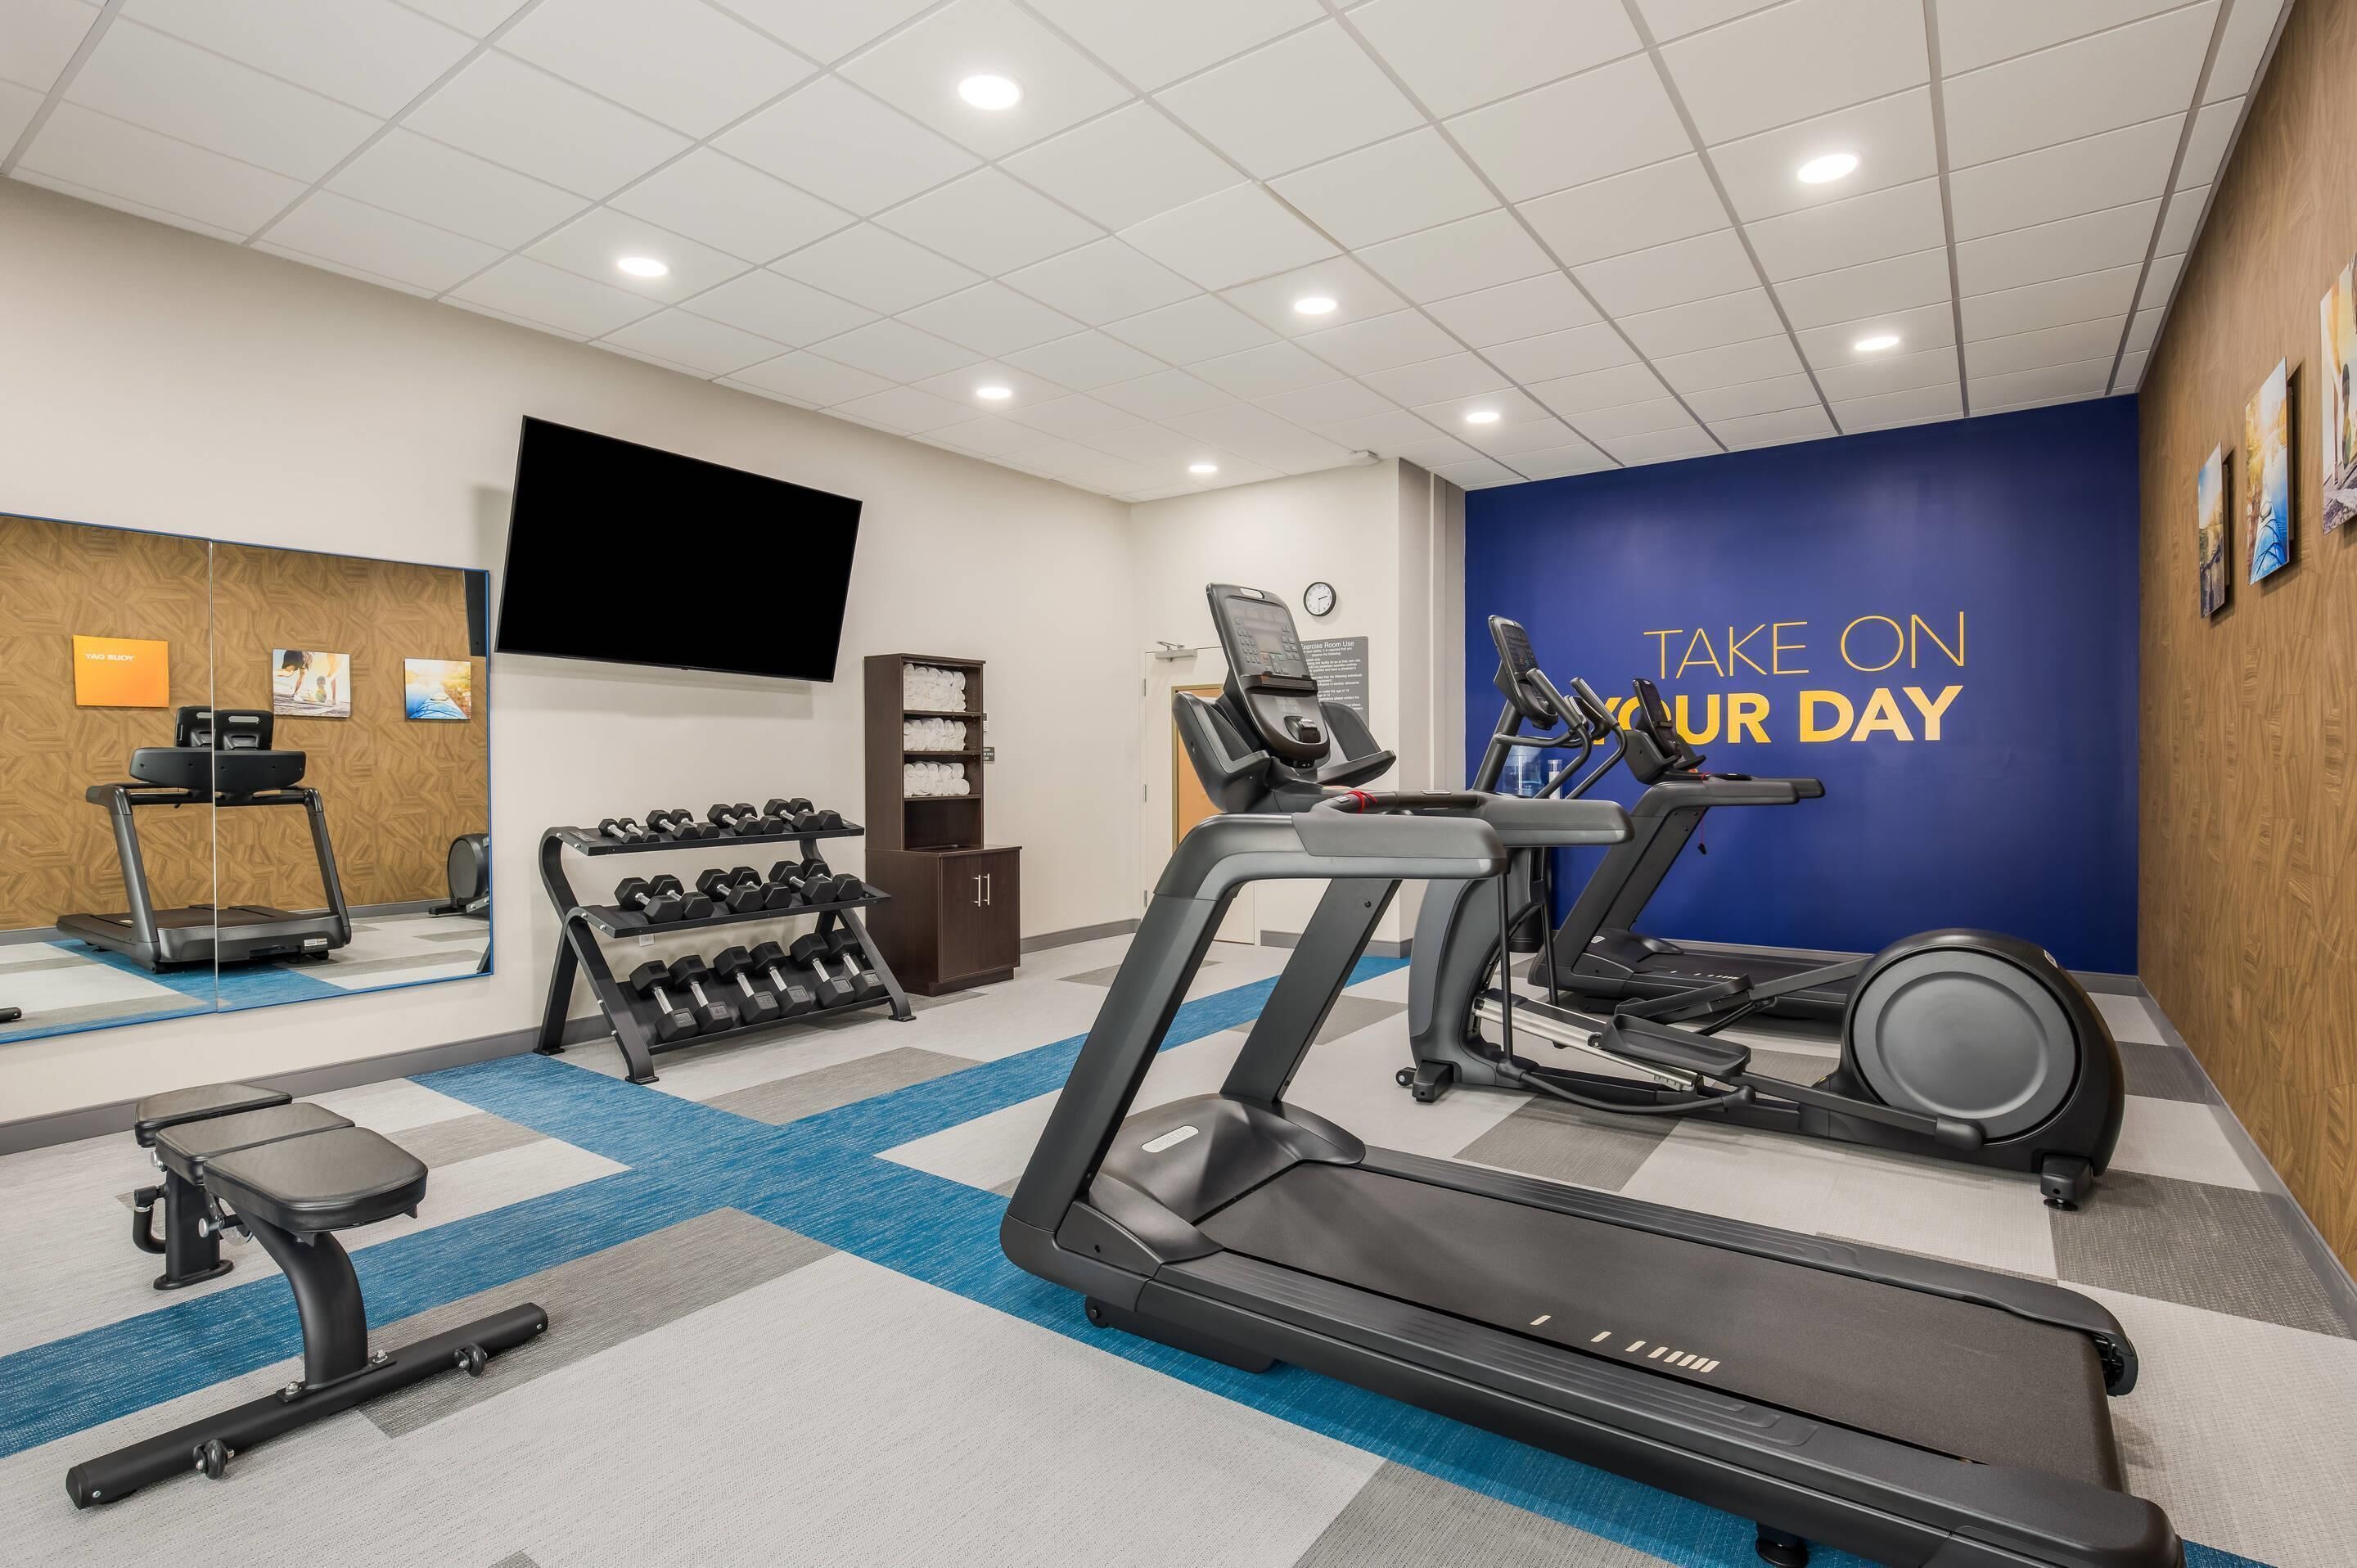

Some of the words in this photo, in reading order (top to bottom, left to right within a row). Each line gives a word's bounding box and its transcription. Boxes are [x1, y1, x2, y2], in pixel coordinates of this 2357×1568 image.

[1643, 621, 1809, 679] TAKE
[1840, 611, 1964, 672] ON
[1593, 692, 1772, 746] OUR
[1800, 685, 1964, 742] DAY
